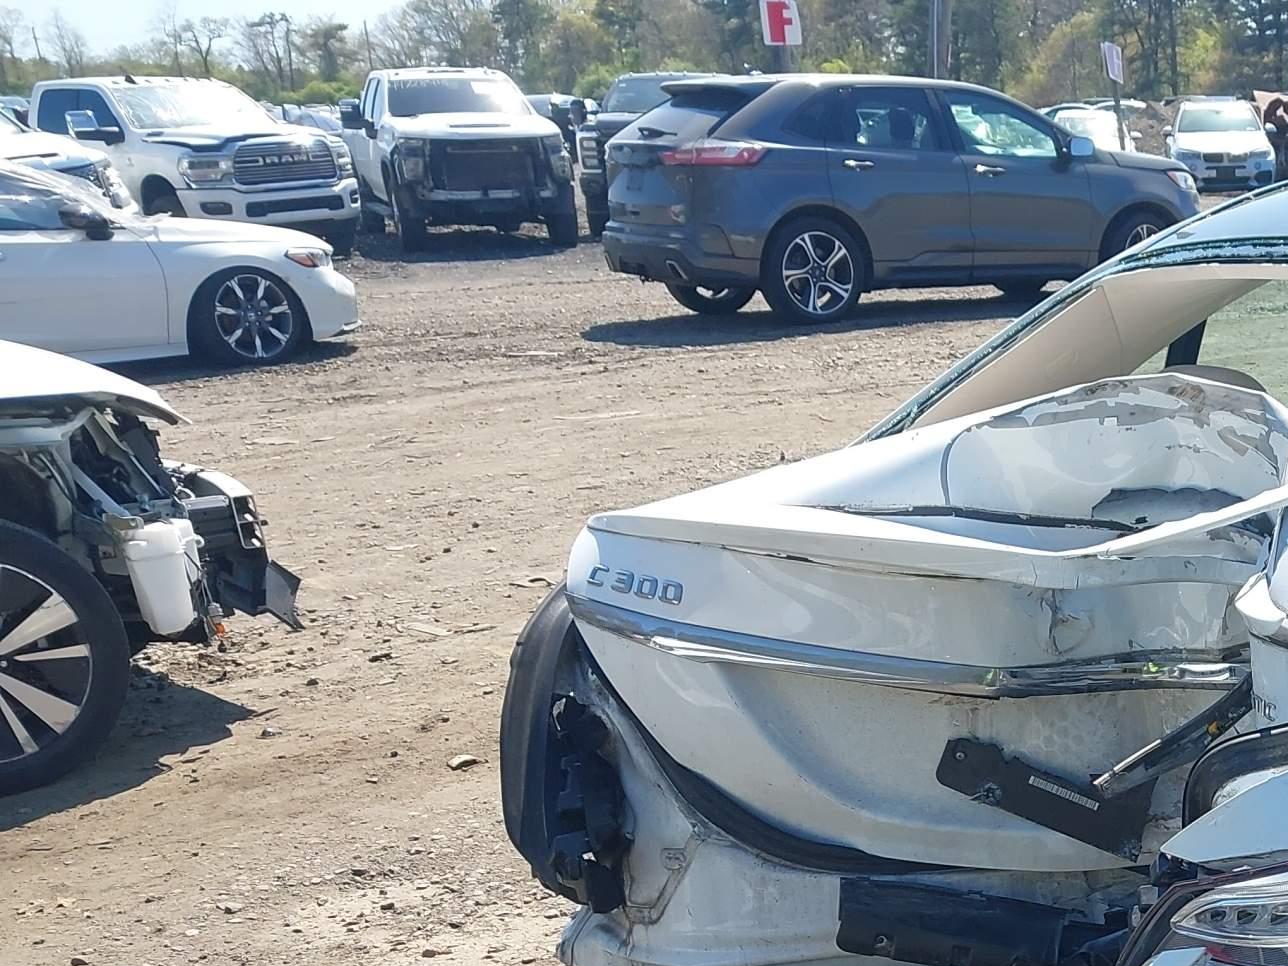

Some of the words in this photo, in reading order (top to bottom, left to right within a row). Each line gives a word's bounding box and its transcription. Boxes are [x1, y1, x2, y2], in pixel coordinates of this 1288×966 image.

[766, 1, 793, 43] F
[264, 151, 308, 165] RAM
[586, 564, 610, 588] C
[610, 569, 684, 606] 300
